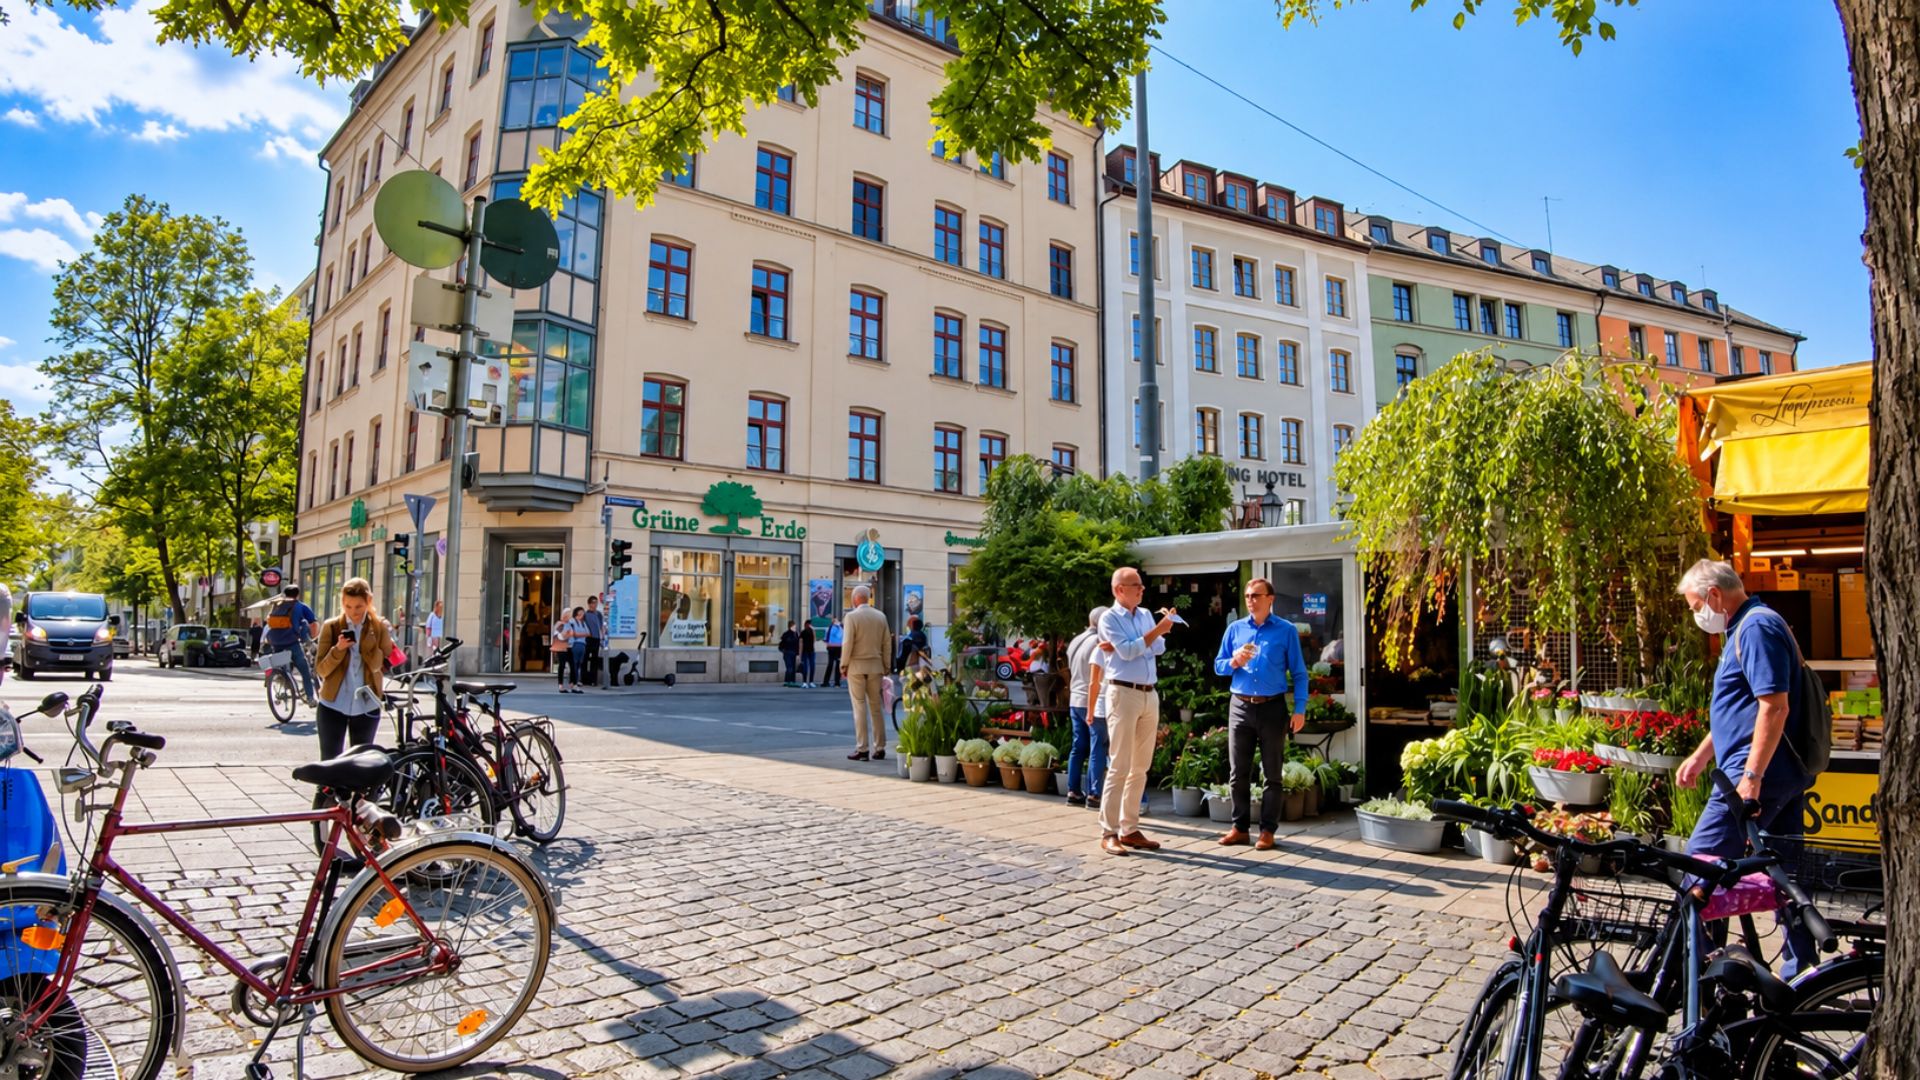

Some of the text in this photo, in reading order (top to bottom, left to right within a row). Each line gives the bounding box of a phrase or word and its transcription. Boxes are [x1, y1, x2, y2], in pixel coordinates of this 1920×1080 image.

[1223, 464, 1307, 488] NG HOTEL
[632, 507, 807, 540] Grüne Erde
